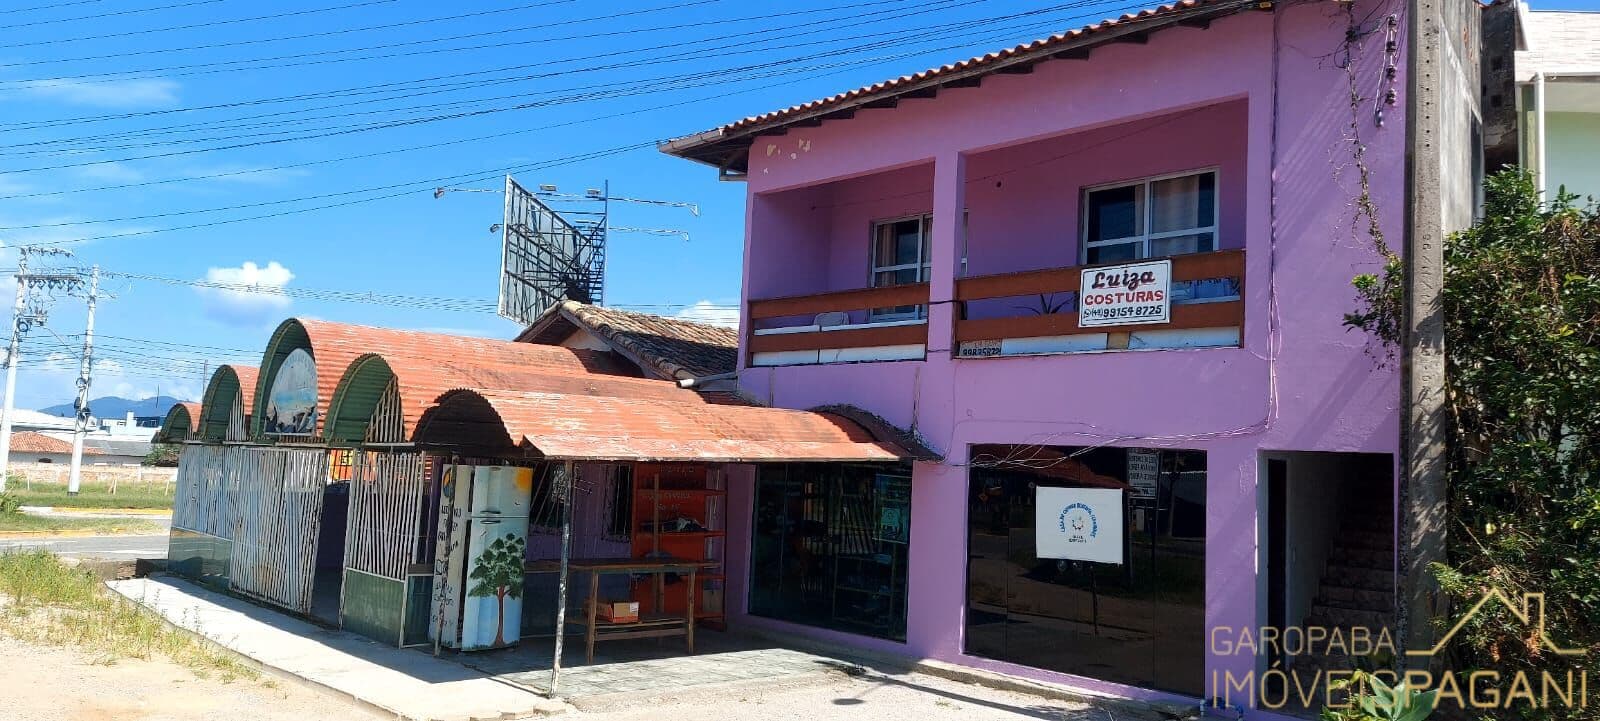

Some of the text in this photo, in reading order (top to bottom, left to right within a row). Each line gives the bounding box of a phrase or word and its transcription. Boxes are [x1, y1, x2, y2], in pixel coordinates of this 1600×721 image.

[1092, 270, 1155, 290] Luiza
[1085, 290, 1163, 305] COSTURAS
[1135, 305, 1163, 315] 8725
